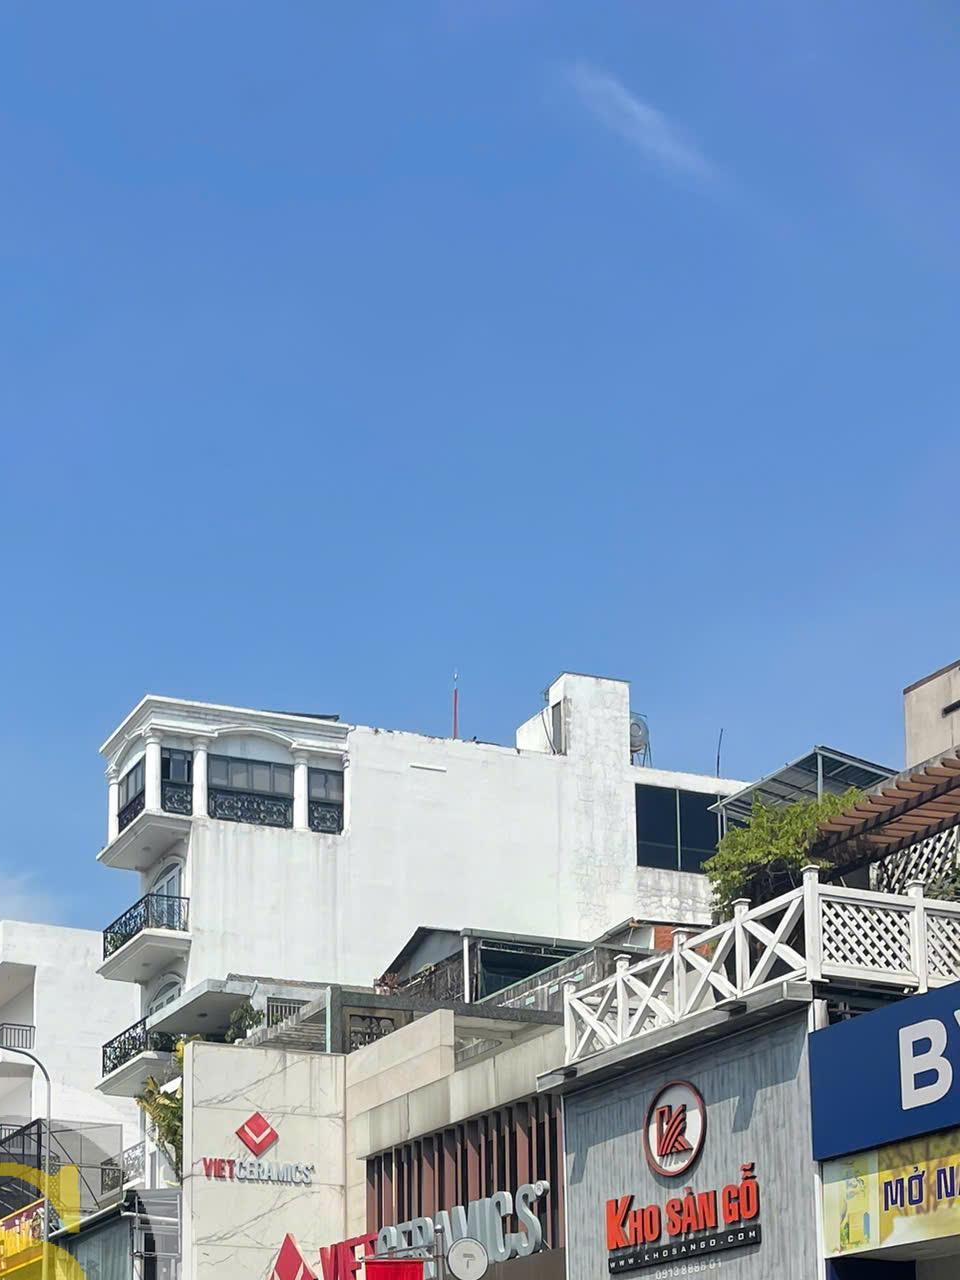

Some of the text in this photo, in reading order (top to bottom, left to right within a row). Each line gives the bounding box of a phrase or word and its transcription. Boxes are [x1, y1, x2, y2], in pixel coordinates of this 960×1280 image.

[899, 1008, 960, 1110] B
[665, 1187, 717, 1236] SÀN
[722, 1162, 760, 1224] GỖ
[883, 1166, 925, 1212] MỞ
[937, 1165, 960, 1200] N
